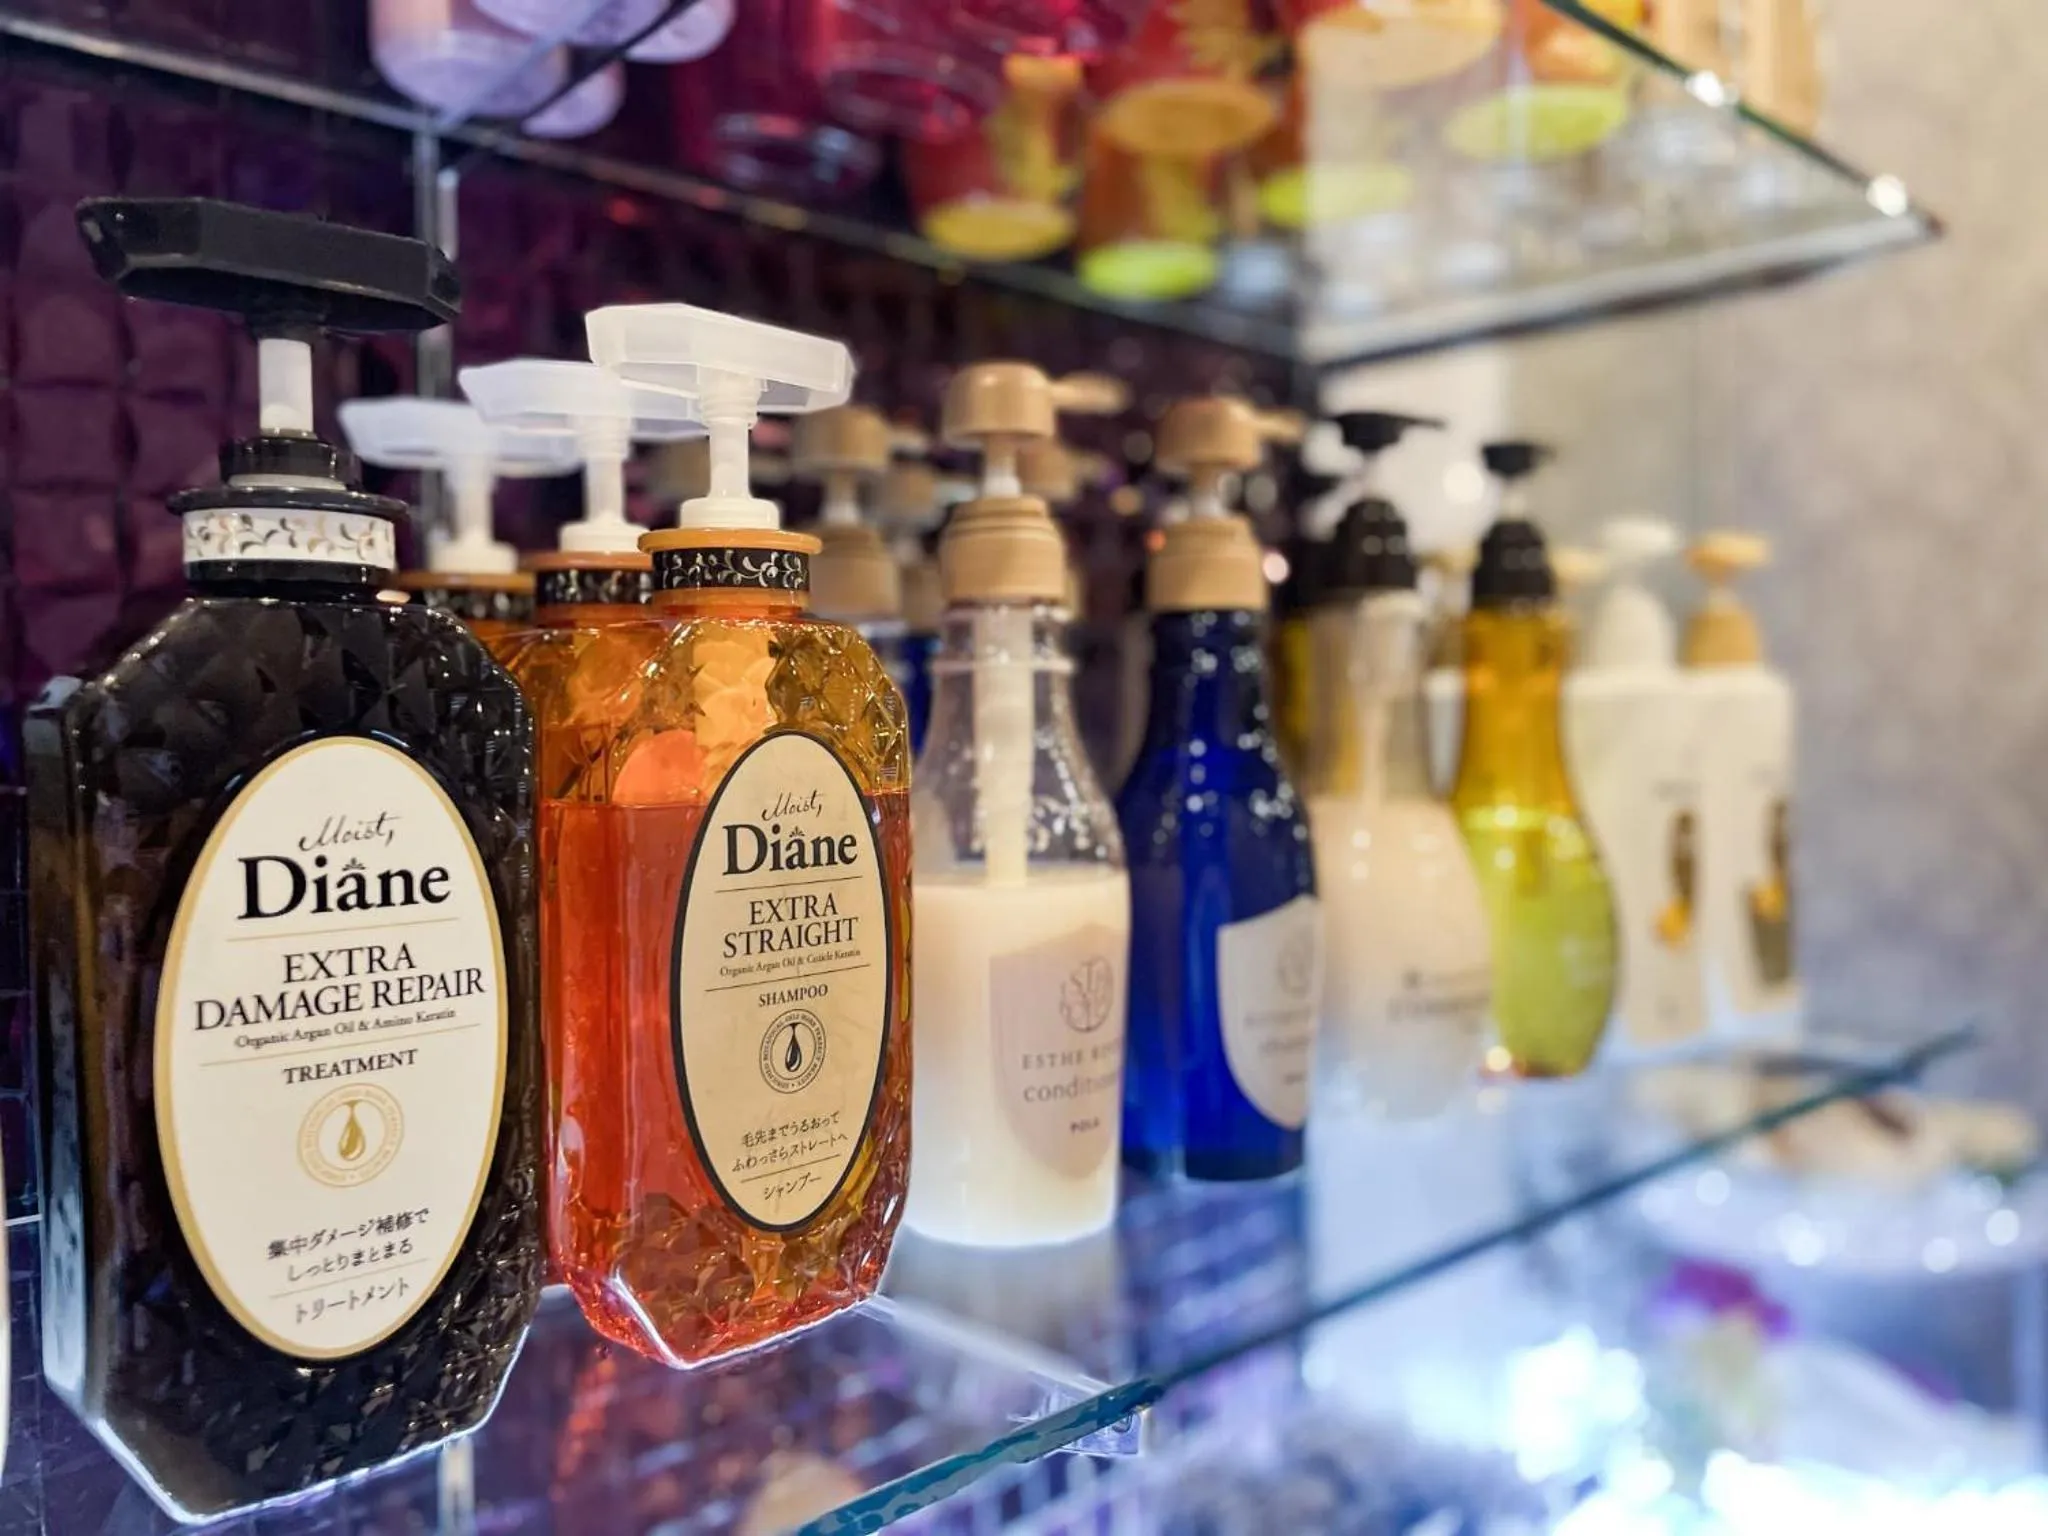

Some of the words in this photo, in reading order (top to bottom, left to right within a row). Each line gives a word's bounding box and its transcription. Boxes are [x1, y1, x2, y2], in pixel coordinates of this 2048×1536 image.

[750, 893, 838, 926] EXTRA
[722, 917, 859, 959] STRAIGHT
[284, 942, 416, 984] EXTRA
[782, 957, 796, 968] Oil
[195, 982, 364, 1031] DAMAGE
[371, 967, 486, 1010] REPAIR
[758, 983, 829, 1007] SHAMPOO
[235, 1035, 288, 1050] Organic
[294, 1028, 332, 1042] Argan
[334, 1021, 355, 1034] Oil
[358, 1019, 370, 1031] &
[372, 1015, 413, 1029] Amino
[416, 1008, 456, 1023] Keratin
[284, 1049, 418, 1084] TREATMENT
[742, 1111, 840, 1148] 毛先までうるおって
[732, 1133, 848, 1173] ふわっさらストレートへ
[764, 1172, 822, 1201] シャンプー
[267, 1207, 430, 1260] 集中ダメージ補修で
[287, 1238, 414, 1282] しっとりまとまる
[295, 1277, 410, 1325] トリートメント
